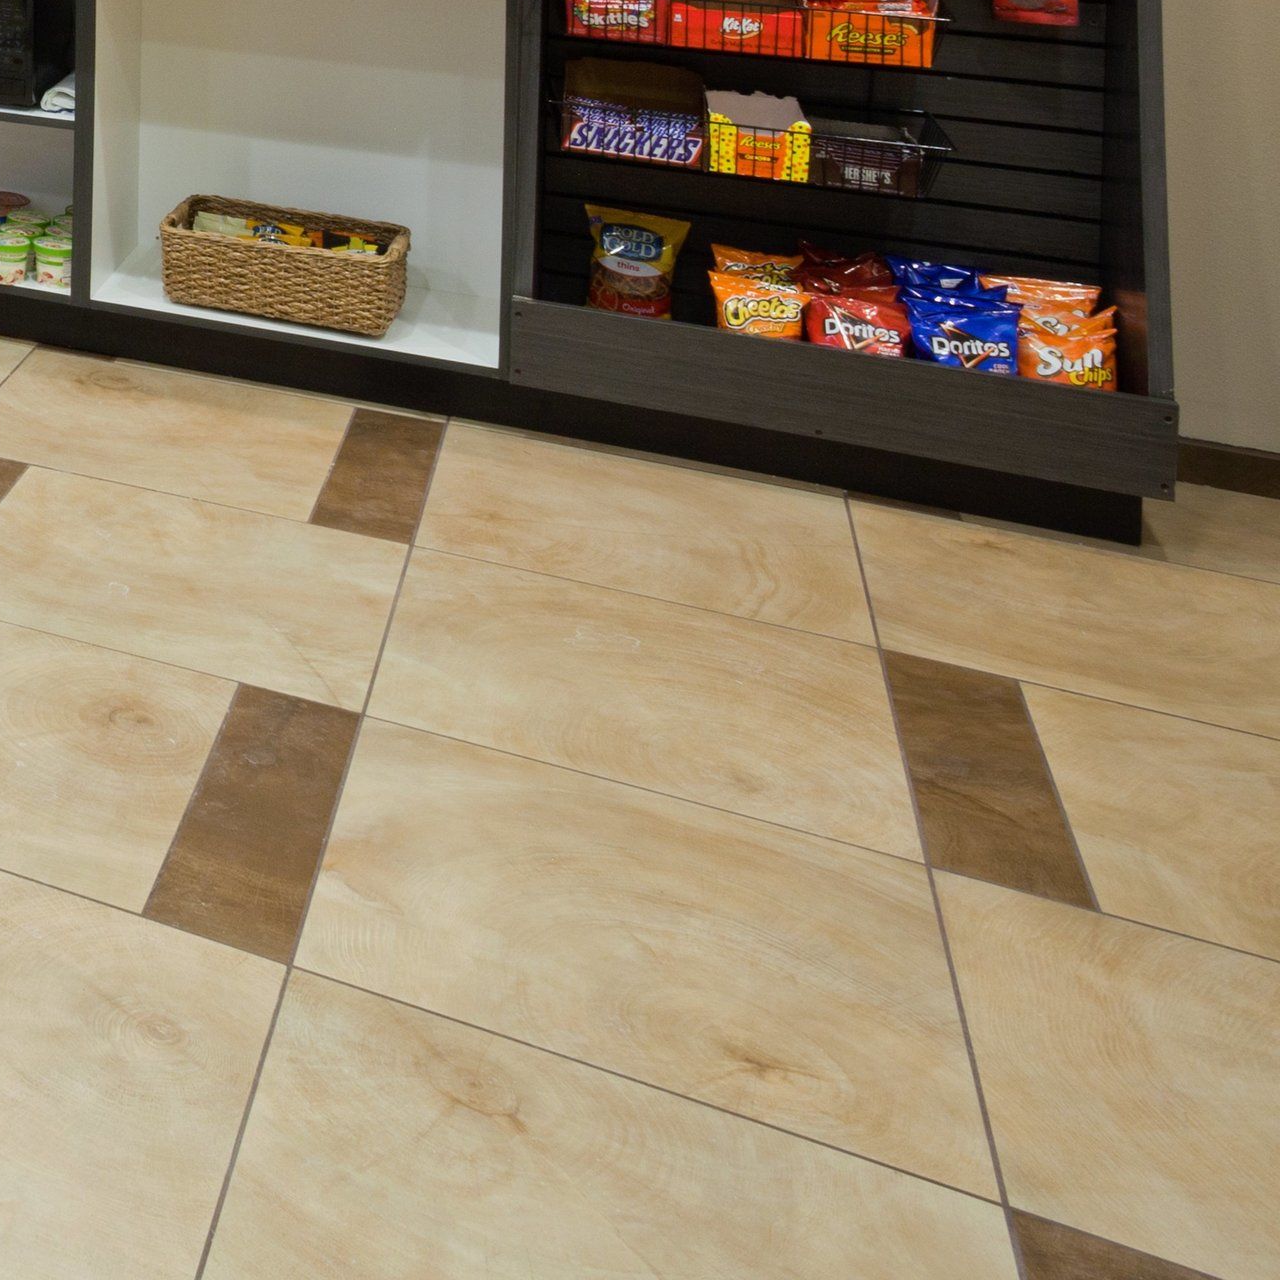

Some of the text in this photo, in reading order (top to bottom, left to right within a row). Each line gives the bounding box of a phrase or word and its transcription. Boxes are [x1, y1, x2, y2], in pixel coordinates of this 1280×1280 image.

[582, 12, 650, 28] Skittles
[571, 122, 700, 162] SNICKERS
[611, 225, 656, 245] ROLD
[604, 236, 657, 259] GOLD
[724, 294, 802, 328] Cheetos
[824, 317, 901, 344] Doritos
[931, 336, 1011, 358] Doritos
[1036, 346, 1103, 376] Sun
[1068, 367, 1112, 388] Chips
